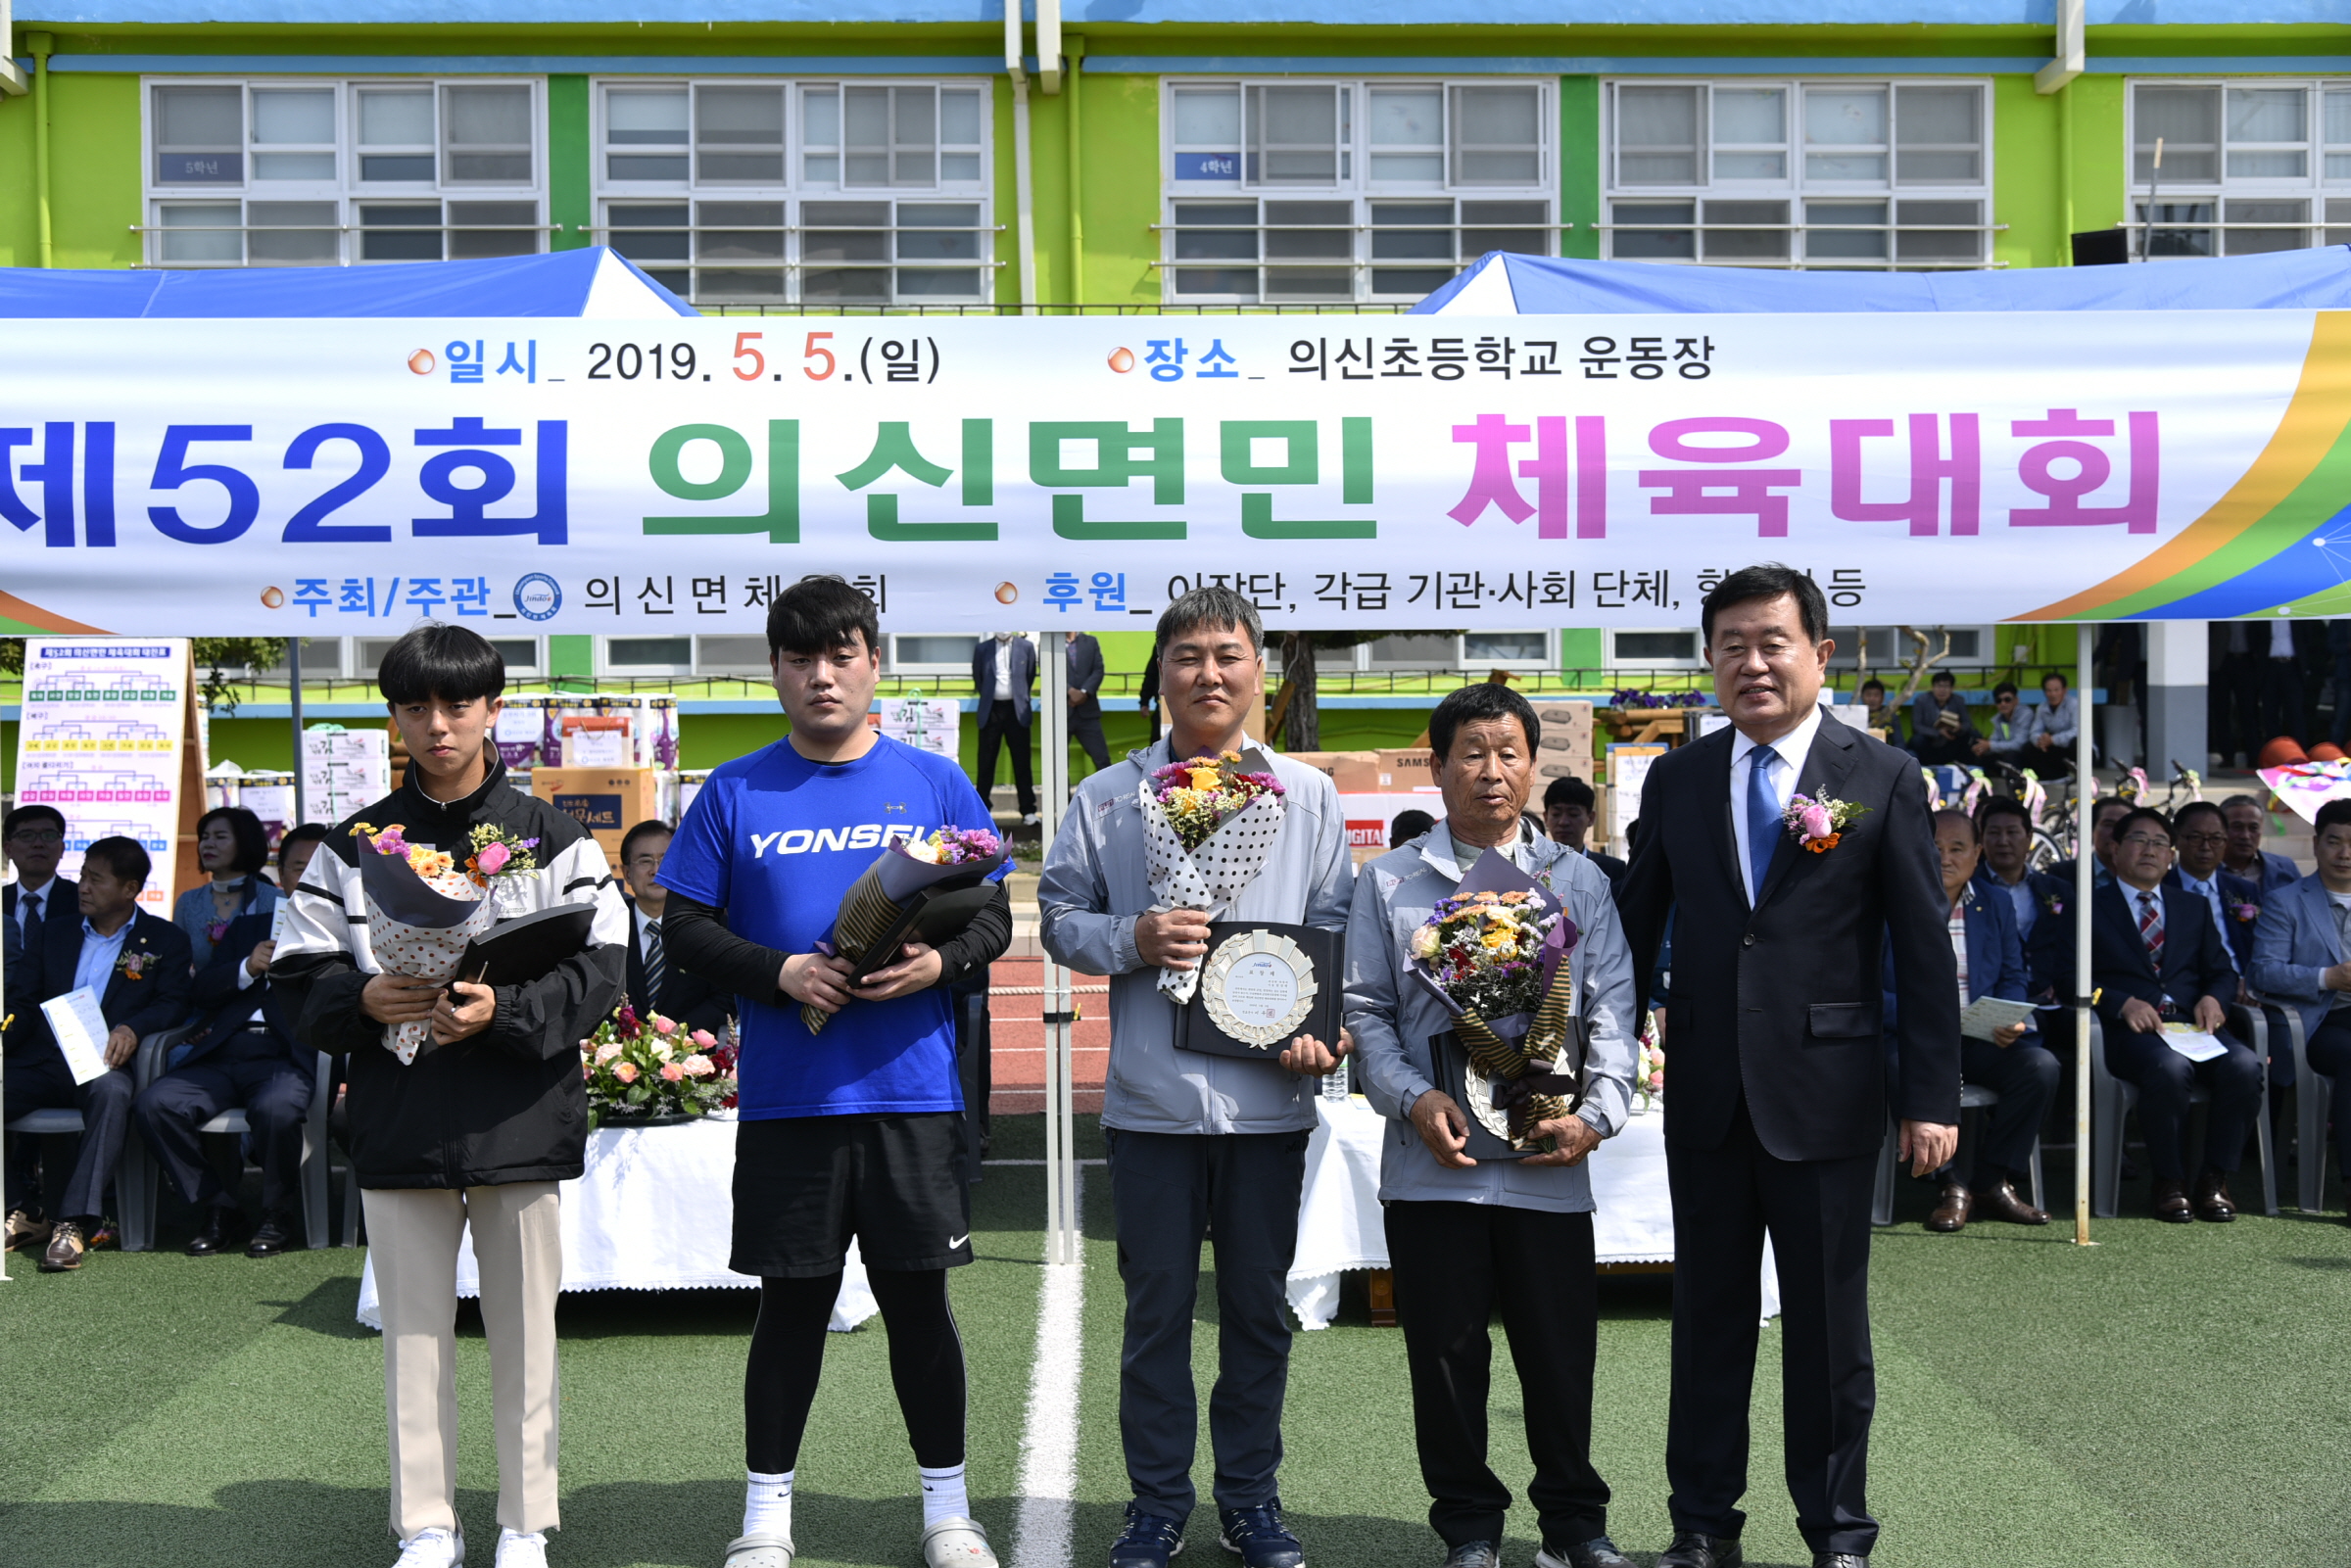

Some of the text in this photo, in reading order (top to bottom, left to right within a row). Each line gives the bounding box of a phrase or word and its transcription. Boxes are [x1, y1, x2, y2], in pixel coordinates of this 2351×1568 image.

[185, 160, 219, 175] 5학년
[1199, 159, 1233, 174] 4학년
[587, 342, 711, 382] 2019.
[1288, 336, 1562, 381] 의신초등학교
[1579, 335, 1715, 380] 운동장
[0, 407, 2159, 547] 제52회 의신면민 체육대회
[585, 573, 887, 616] 의신면체회
[1314, 571, 1391, 611] 각급
[1593, 568, 1680, 611] 단체,
[1827, 568, 1867, 607] 등
[1397, 758, 1430, 767] SAMS
